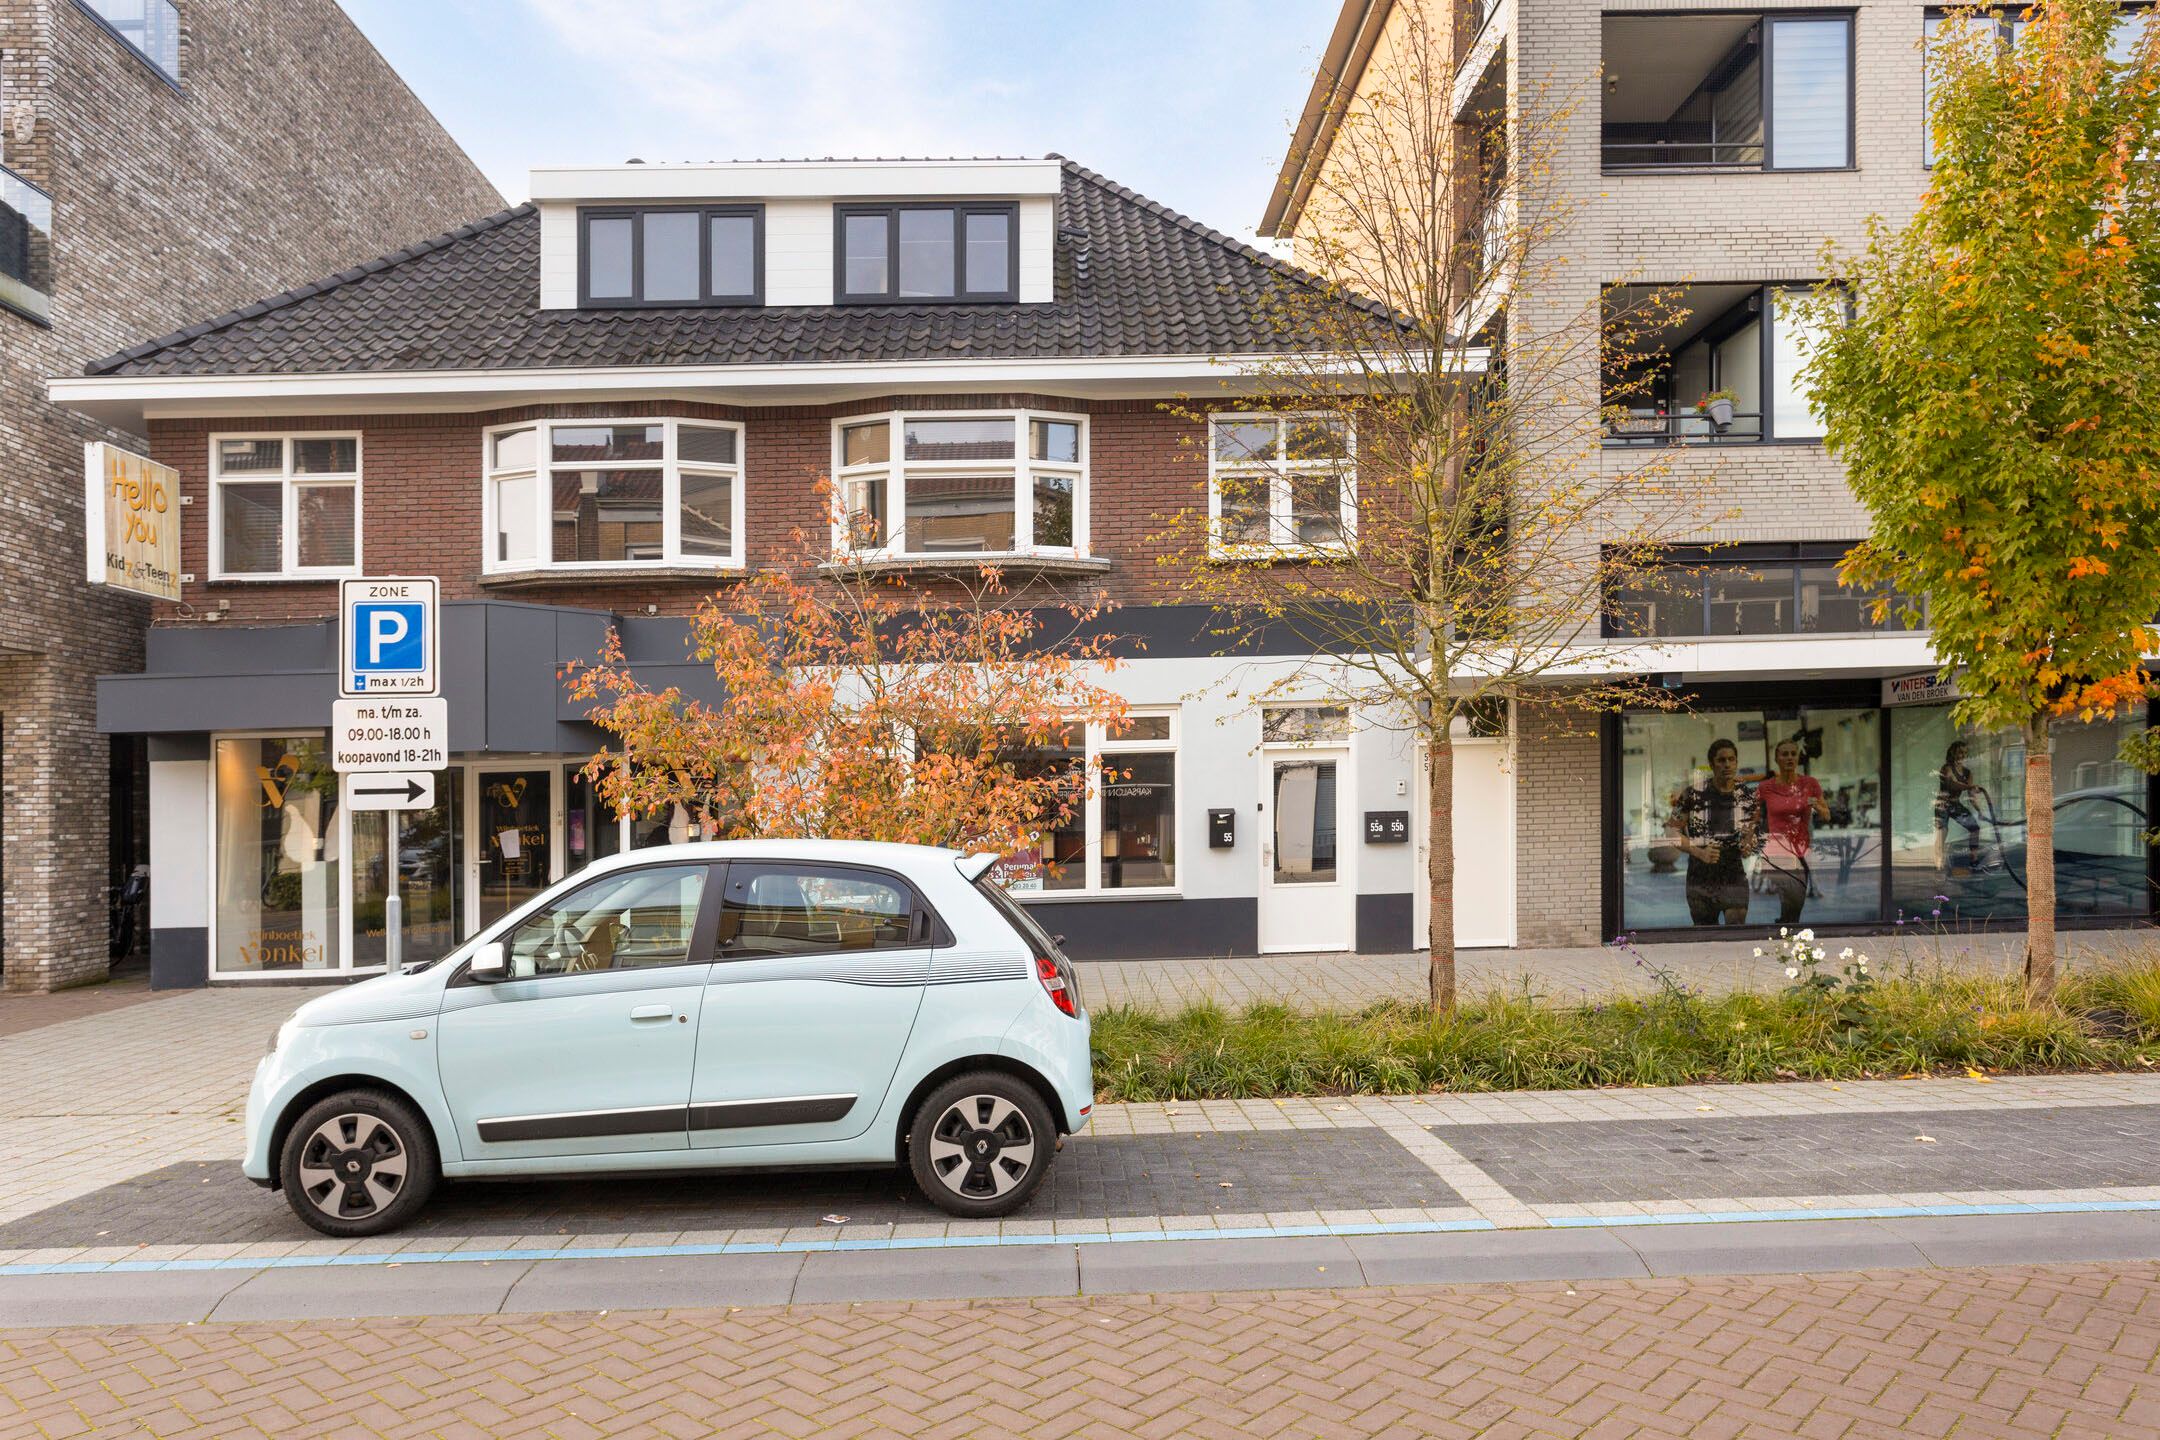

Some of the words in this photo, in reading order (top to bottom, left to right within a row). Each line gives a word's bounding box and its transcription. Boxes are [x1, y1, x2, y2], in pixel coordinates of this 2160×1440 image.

[111, 459, 168, 514] Hello
[369, 586, 409, 597] ZONE
[370, 610, 409, 664] P
[370, 678, 397, 687] max
[1897, 692, 1911, 702] VAN
[1912, 690, 1925, 700] DEN
[1926, 687, 1948, 698] BROEK
[357, 708, 379, 719] ma.
[381, 705, 402, 719] t/m
[405, 707, 422, 718] za.
[348, 727, 421, 741] 09.00-18.00
[424, 727, 431, 740] h
[338, 750, 400, 765] koopavond
[404, 749, 441, 762] 18-21h
[1370, 822, 1383, 832] 55a
[1391, 822, 1404, 832] 55b
[1223, 832, 1233, 842] 55
